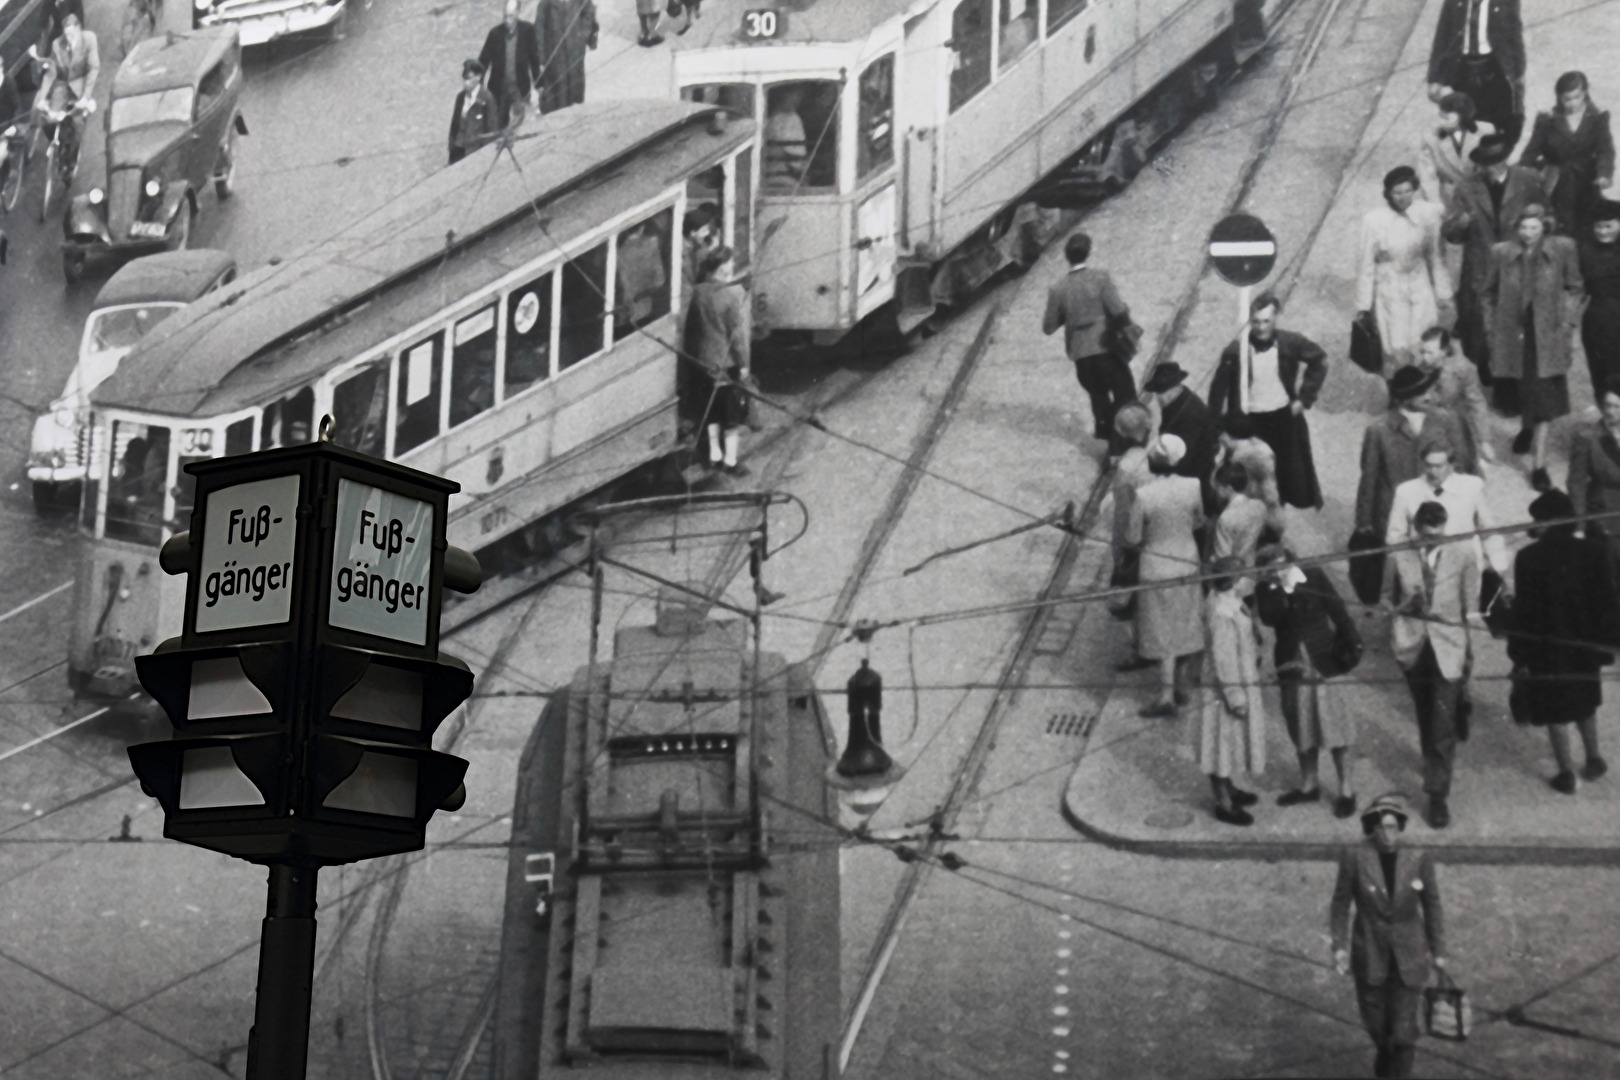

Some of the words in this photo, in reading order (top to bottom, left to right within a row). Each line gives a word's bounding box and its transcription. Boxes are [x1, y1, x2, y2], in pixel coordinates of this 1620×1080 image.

[746, 11, 777, 37] 30
[184, 428, 214, 453] 30
[227, 504, 283, 547] Fuß-
[359, 509, 416, 559] Fuß-
[205, 560, 291, 608] gänger
[336, 561, 425, 614] gänger
